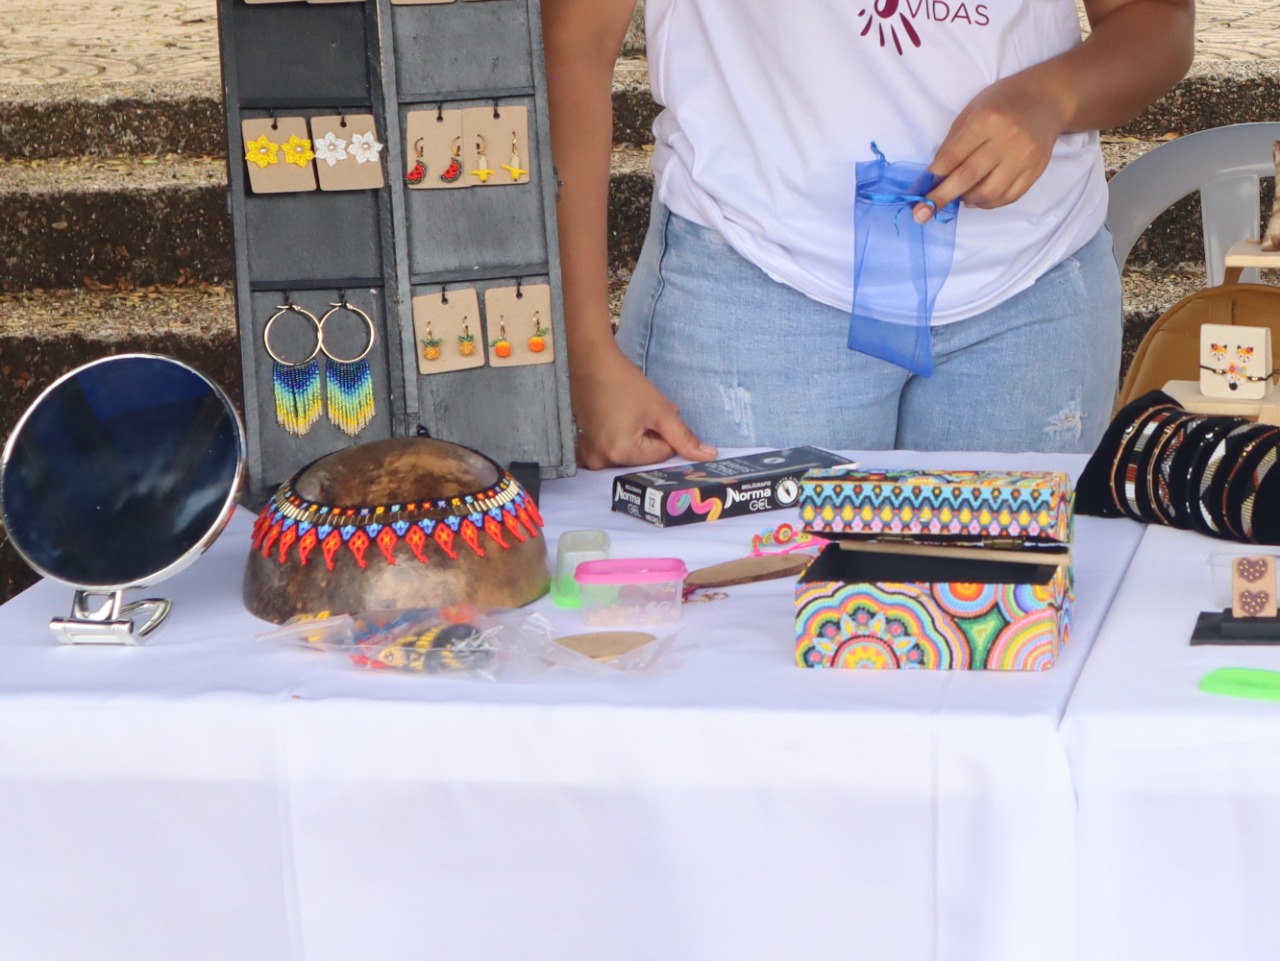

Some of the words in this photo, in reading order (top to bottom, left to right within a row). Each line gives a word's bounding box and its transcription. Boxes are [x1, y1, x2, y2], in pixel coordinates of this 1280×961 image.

[614, 481, 641, 506] Norma
[724, 486, 771, 509] Norma
[627, 504, 642, 518] GEL
[749, 499, 772, 511] GEL
